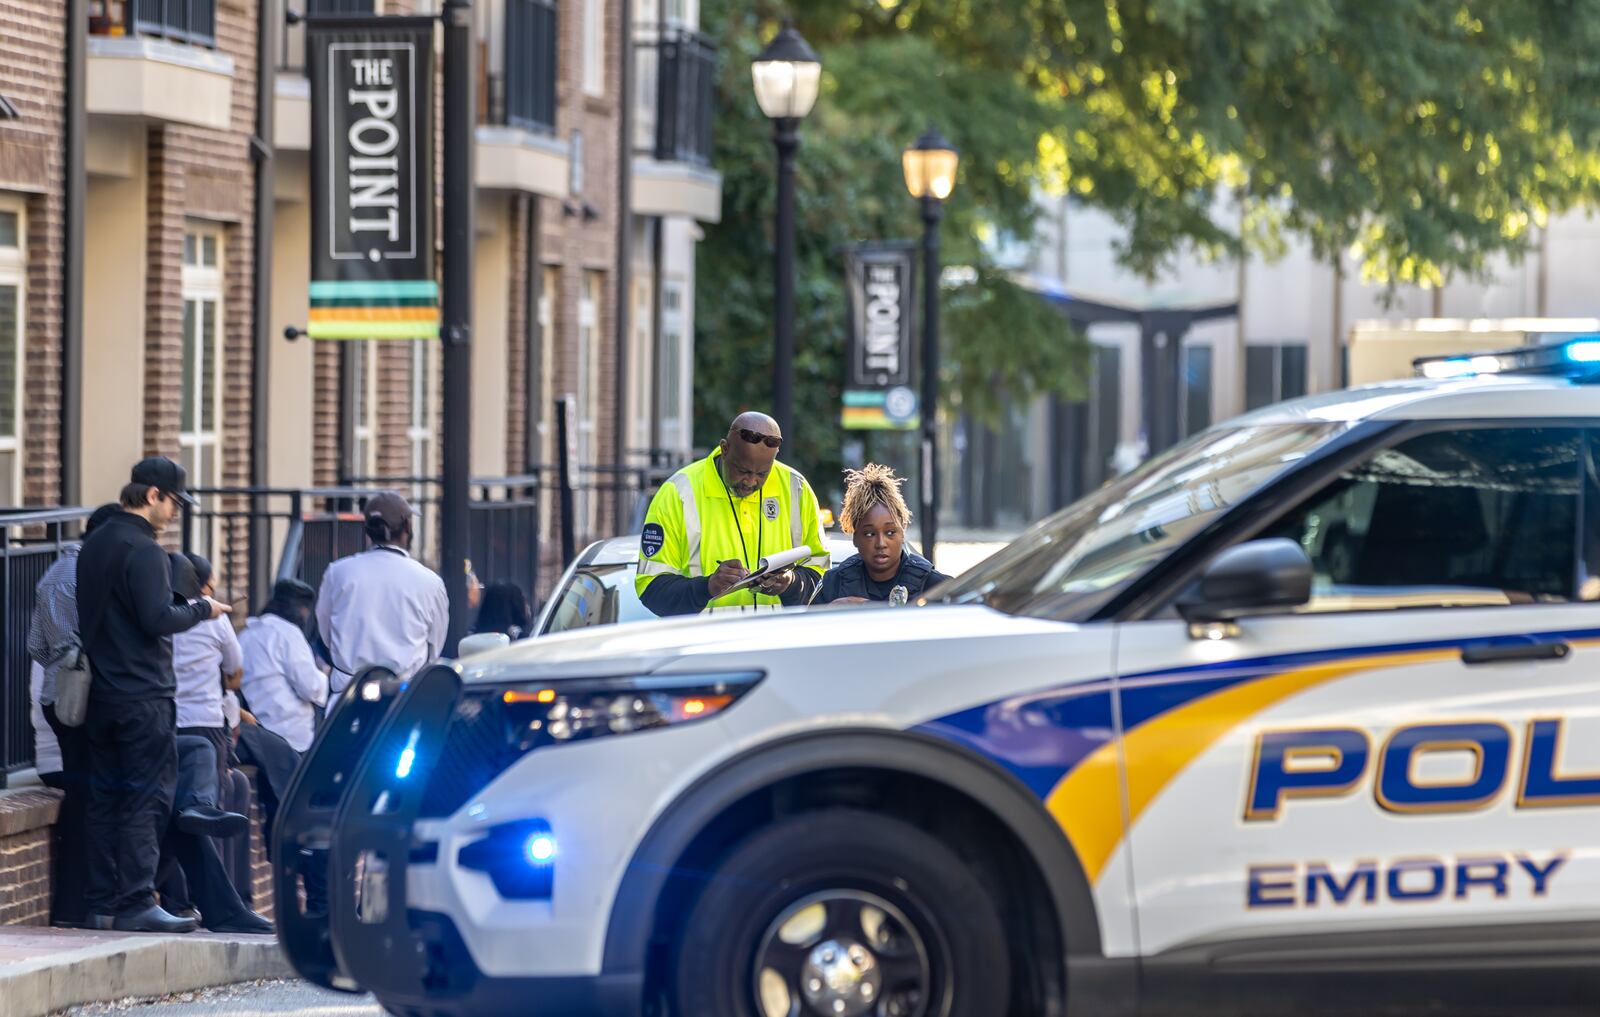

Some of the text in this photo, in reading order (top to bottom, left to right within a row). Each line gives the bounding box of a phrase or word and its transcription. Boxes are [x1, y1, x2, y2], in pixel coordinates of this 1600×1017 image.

[351, 58, 393, 85] THE
[348, 88, 400, 242] POINT
[865, 282, 900, 375] POINT
[1243, 715, 1600, 822] POL
[1246, 850, 1570, 911] EMORY
